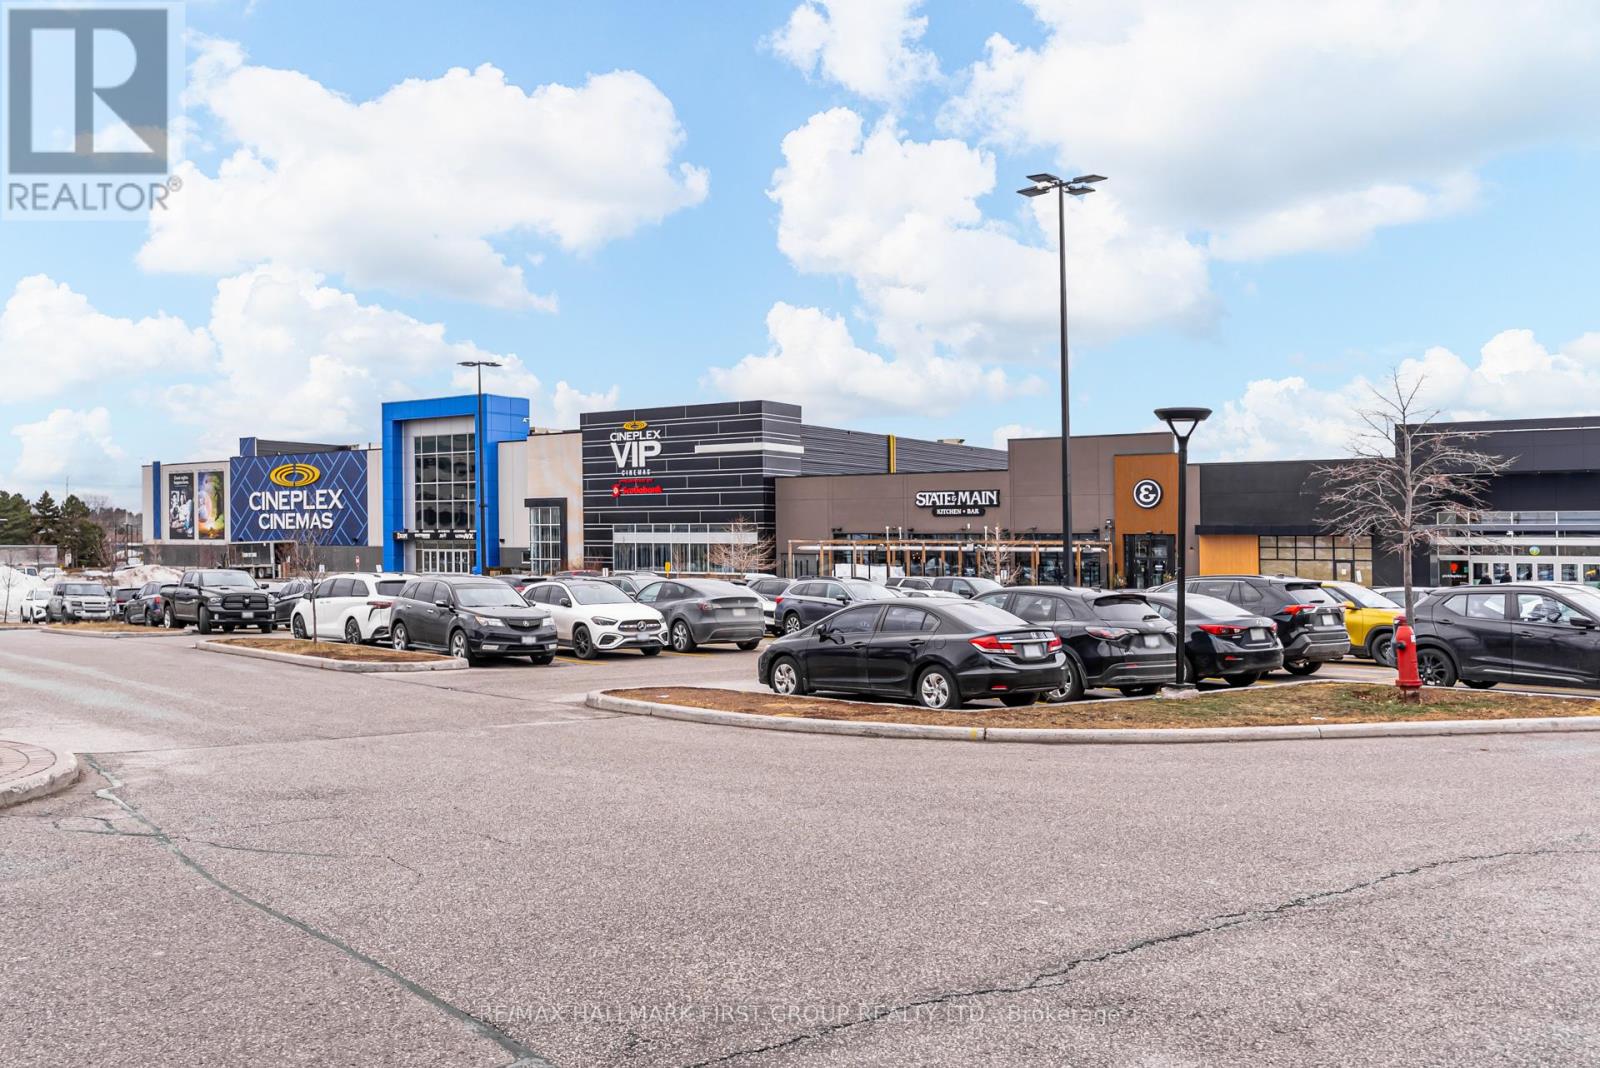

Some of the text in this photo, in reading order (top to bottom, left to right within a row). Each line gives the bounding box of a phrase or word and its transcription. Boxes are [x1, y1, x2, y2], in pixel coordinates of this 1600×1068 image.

[609, 430, 661, 441] CINEPLEX
[610, 441, 662, 468] VIP
[248, 489, 344, 511] CINEPLEX
[915, 491, 955, 506] STATE
[957, 490, 998, 506] MAIN
[258, 512, 334, 530] CINEMAS
